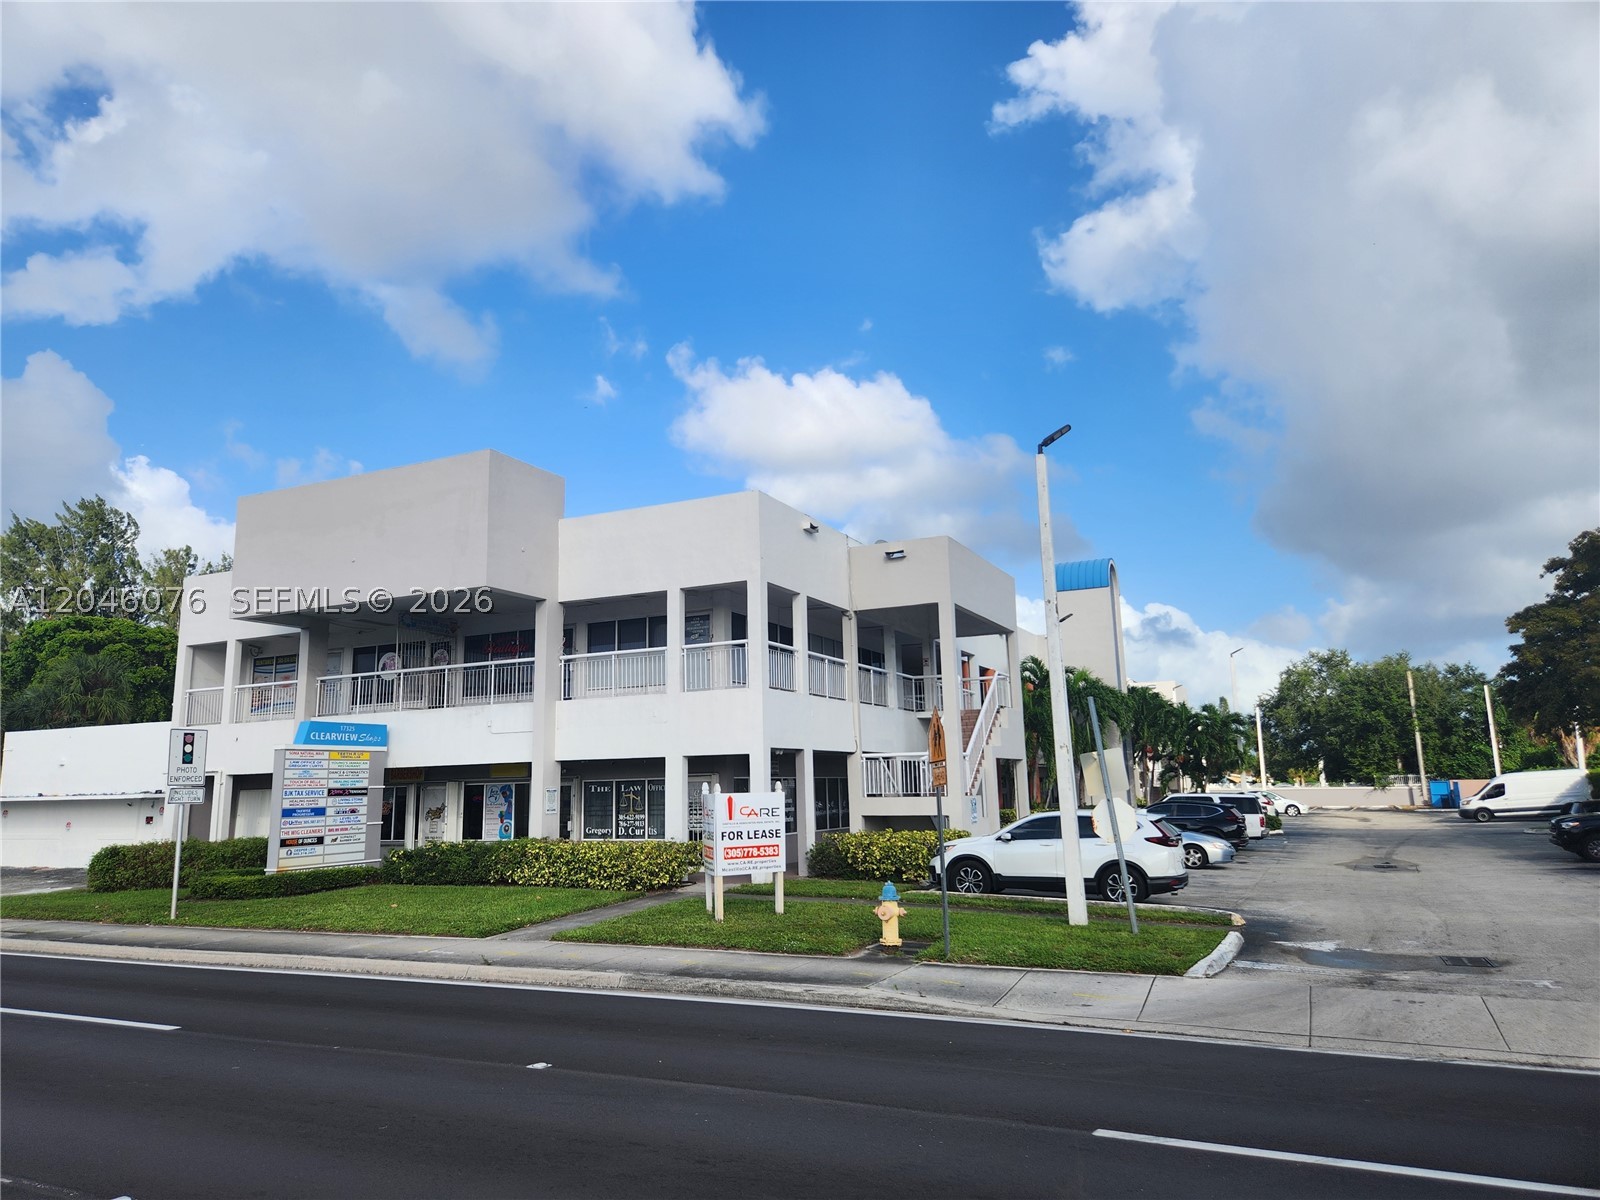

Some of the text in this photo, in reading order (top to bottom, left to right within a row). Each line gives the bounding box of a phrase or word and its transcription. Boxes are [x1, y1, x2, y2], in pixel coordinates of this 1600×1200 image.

[310, 731, 381, 744] CLEARVIEW Shops
[176, 766, 198, 774] PHOTO
[169, 775, 203, 783] ENFORCED
[585, 826, 613, 836] Gregory
[618, 827, 628, 836] D.
[721, 831, 744, 841] FOR
[747, 829, 782, 840] LEASE
[724, 846, 779, 859] (305)778-5383
